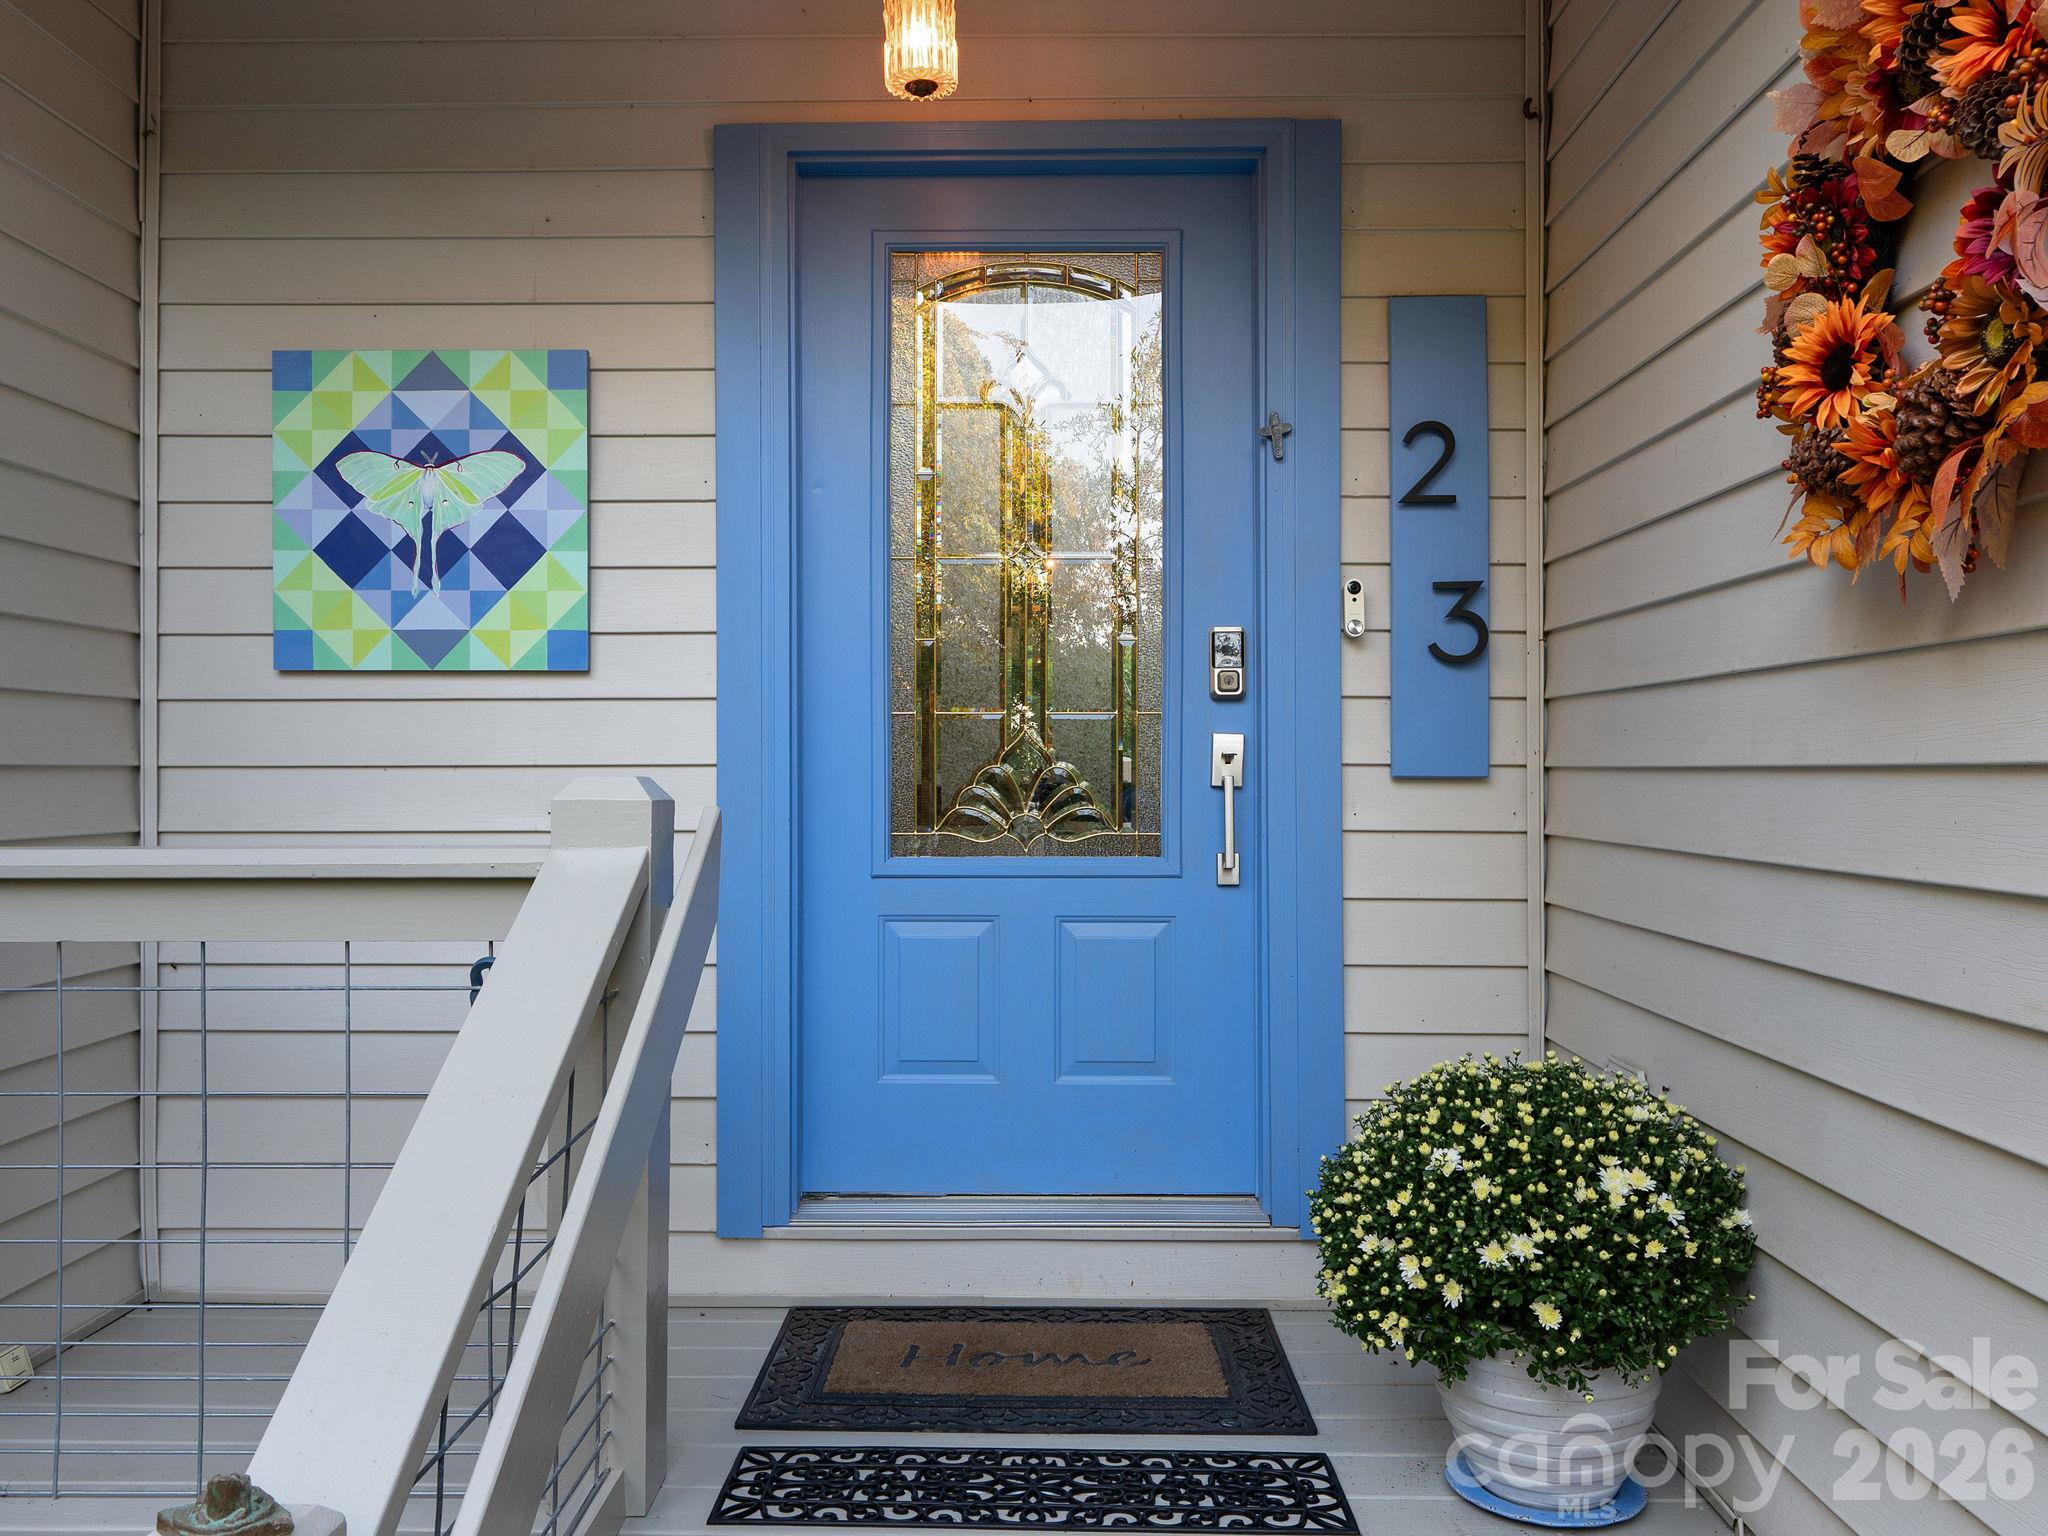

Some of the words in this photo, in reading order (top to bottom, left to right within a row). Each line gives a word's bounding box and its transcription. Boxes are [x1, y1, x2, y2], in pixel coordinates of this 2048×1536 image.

[1397, 420, 1457, 503] 2
[1428, 580, 1489, 664] 3
[899, 1341, 1152, 1369] Home
